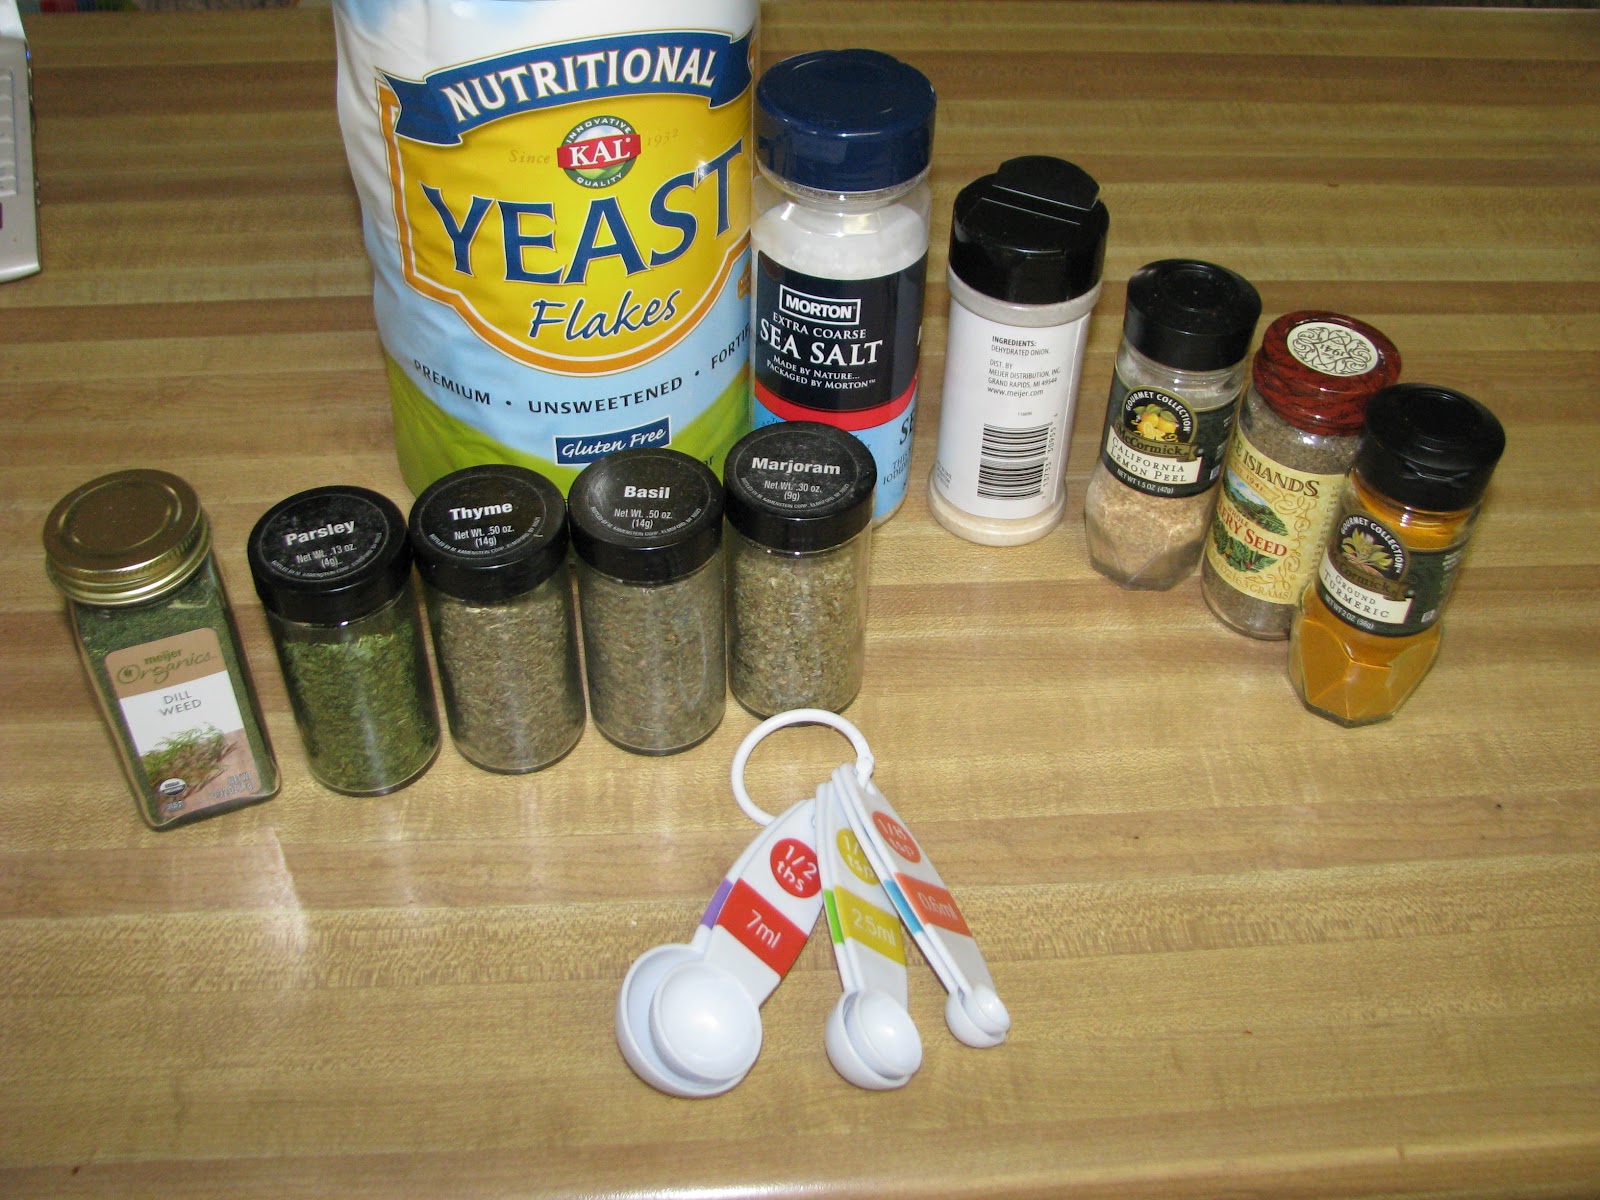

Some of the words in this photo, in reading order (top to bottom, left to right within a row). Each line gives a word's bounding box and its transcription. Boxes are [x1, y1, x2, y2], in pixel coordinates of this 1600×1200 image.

[441, 46, 717, 123] NUTRITIONAL
[566, 117, 632, 144] INNOVATIVE
[646, 128, 679, 147] 1932
[509, 150, 550, 165] Since
[568, 139, 631, 167] KAL
[576, 172, 623, 188] QUALITY
[420, 138, 742, 285] YEAST
[528, 289, 683, 341] Flakes
[785, 294, 853, 320] MORTON
[773, 311, 809, 336] EXTRA
[813, 327, 867, 340] COARSE
[760, 318, 802, 360] SEA
[810, 339, 883, 366] SALT
[991, 344, 1030, 356] DEHYDRATED
[992, 335, 1037, 347] INGREDIENTS:
[766, 359, 808, 385] PACKAGED
[810, 378, 824, 388] BY
[773, 354, 797, 372] MADE
[799, 366, 811, 375] BY
[988, 368, 1009, 378] MEIJER
[989, 359, 1004, 369] DIST.
[1005, 362, 1013, 370] BY
[413, 358, 491, 405] PREMIUM
[528, 376, 684, 415] UNSWEETENED
[987, 377, 1008, 387] GRAND
[1009, 381, 1032, 389] RAPIDS,
[987, 386, 1044, 398] www.meijer.com
[1125, 391, 1154, 412] GOURMET
[1156, 393, 1192, 433] COLLECTION
[561, 438, 626, 459] Gluten
[629, 426, 667, 448] Free
[1110, 447, 1148, 477] LEMON
[1154, 470, 1187, 482] PEEL
[1112, 436, 1185, 473] CALIFORNIA
[751, 457, 841, 475] Marjoram
[1242, 451, 1320, 497] ISLANDS
[623, 485, 671, 499] Basil
[763, 479, 778, 490] Net
[810, 484, 822, 493] oz.
[783, 491, 800, 502] (9g)
[1146, 483, 1156, 492] OZ
[449, 502, 513, 521] Thyme
[613, 508, 629, 518] Net
[630, 508, 643, 518] Wt.
[645, 509, 660, 519] .50
[661, 511, 673, 519] oz.
[285, 520, 355, 547] Parsley
[454, 529, 469, 541] Net
[470, 528, 485, 538] Wt.
[487, 525, 501, 536] .50
[502, 525, 515, 534] oz.
[631, 518, 654, 529] (14g)
[475, 536, 497, 549] (14g)
[1244, 528, 1288, 557] SEED
[1340, 515, 1369, 535] GOURMET
[1370, 522, 1405, 570] COLLECTION
[296, 553, 312, 565] Net
[329, 545, 343, 556] .13
[345, 543, 357, 552] oz.
[321, 556, 339, 569] (4g)
[1324, 568, 1390, 618] TURMERIC
[1335, 575, 1376, 605] GROUND
[144, 648, 183, 665] meijer
[116, 651, 211, 685] Organics
[158, 698, 202, 716] WEED
[163, 690, 193, 705] DILL
[785, 845, 817, 880] 1/2
[746, 908, 782, 949] 7ml
